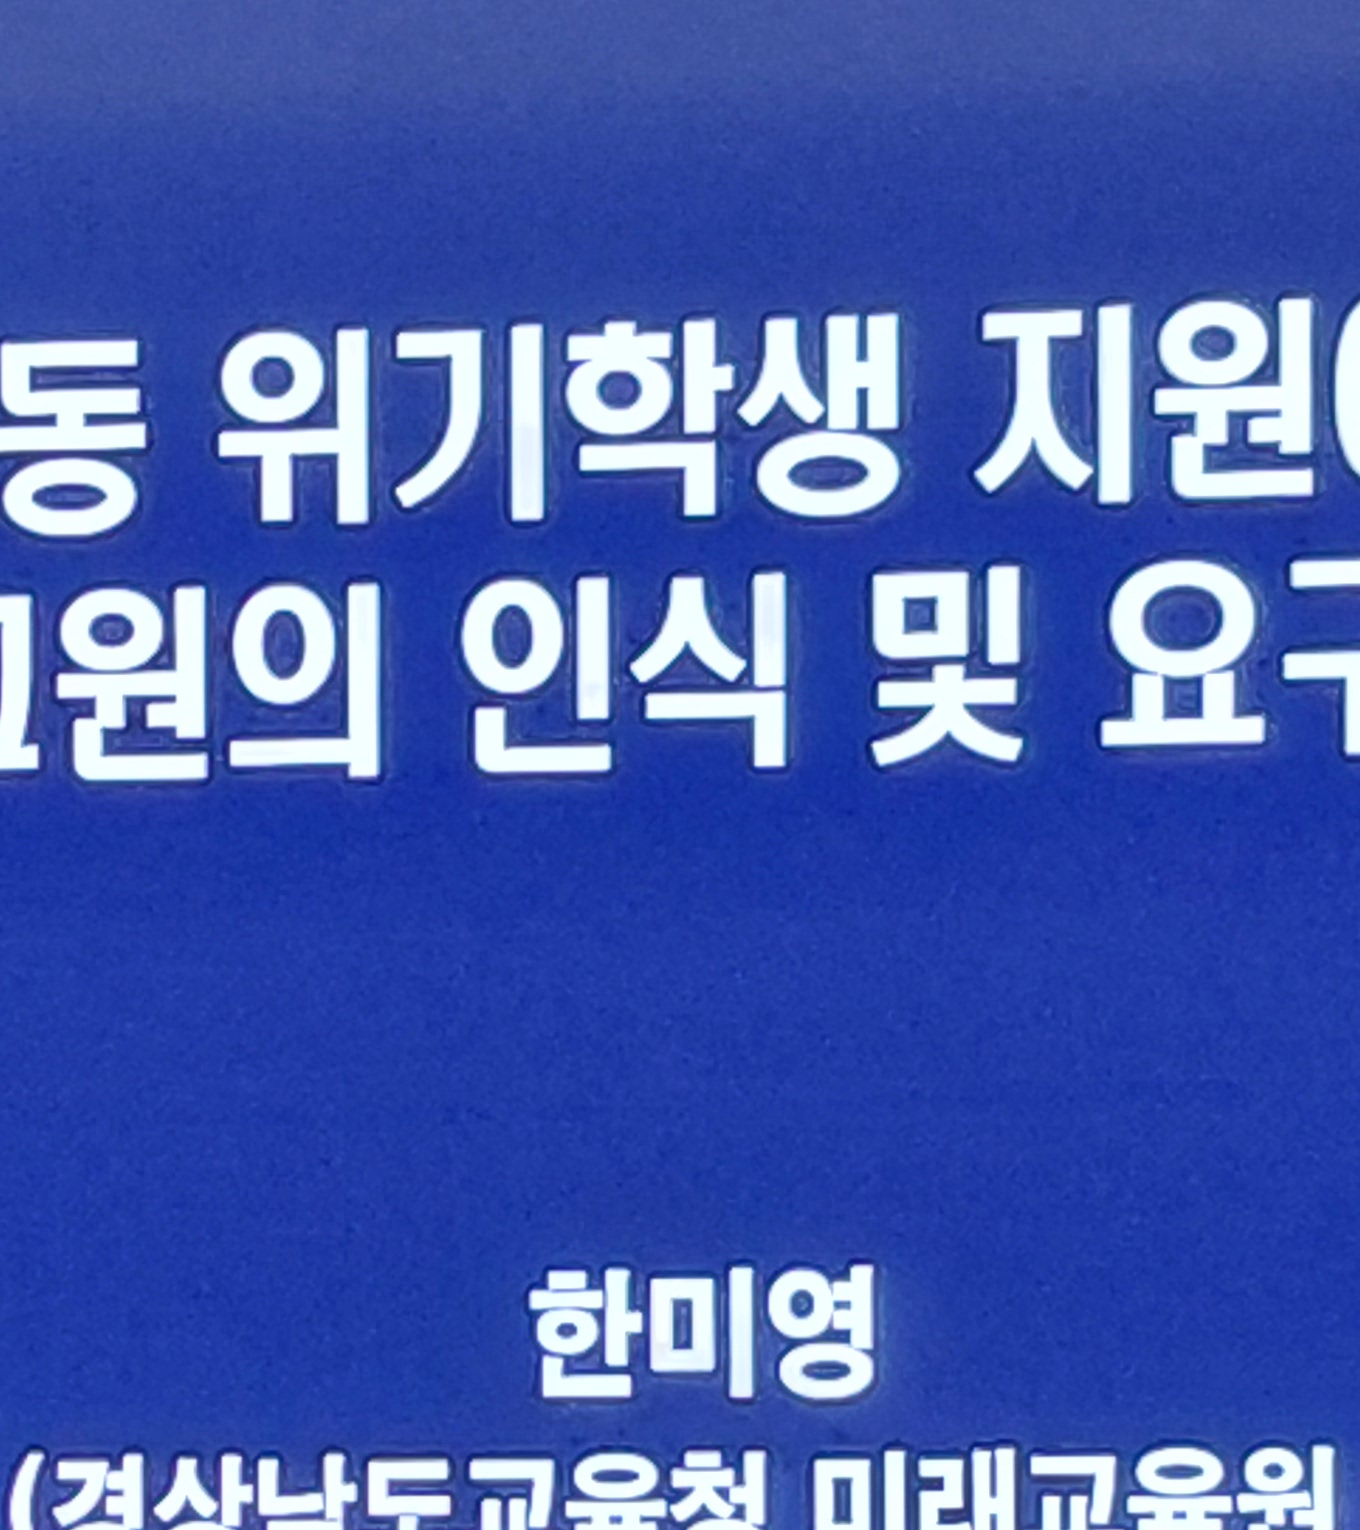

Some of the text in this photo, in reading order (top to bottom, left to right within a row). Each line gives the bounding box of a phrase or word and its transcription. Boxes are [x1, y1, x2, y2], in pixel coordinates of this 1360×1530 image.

[217, 312, 900, 525] 위기학생
[460, 571, 787, 774] 인식
[870, 564, 1024, 767] 및
[528, 1263, 875, 1400] 한미영
